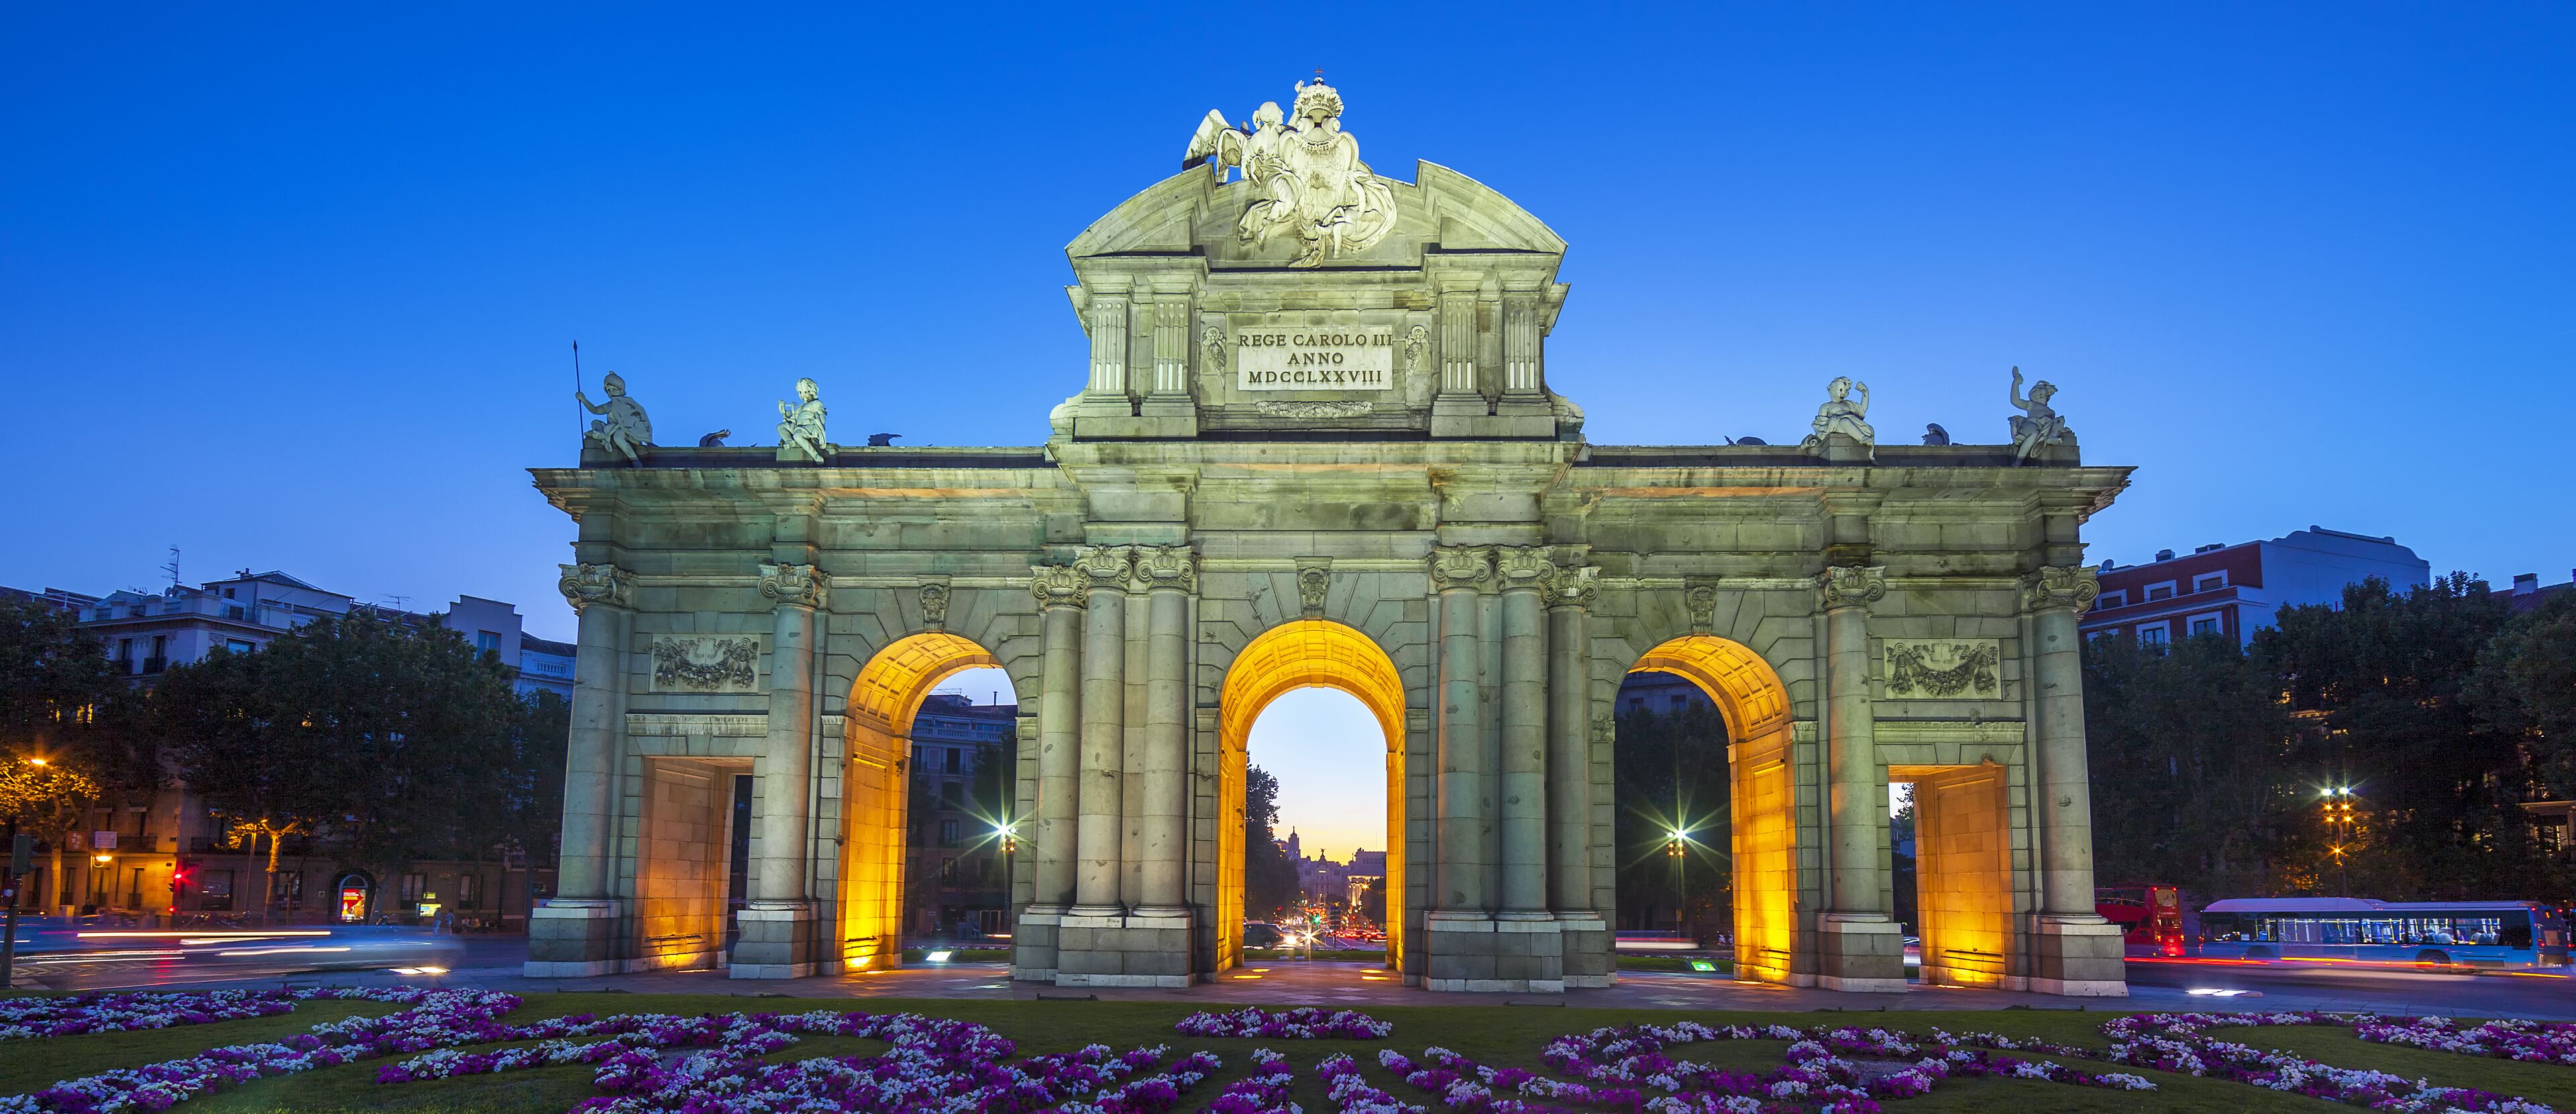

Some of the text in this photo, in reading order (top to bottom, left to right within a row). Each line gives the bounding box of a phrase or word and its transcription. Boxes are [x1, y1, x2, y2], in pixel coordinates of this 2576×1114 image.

[1238, 334, 1393, 346] REGE CAROLO III
[1287, 352, 1344, 365] ANNO
[1248, 370, 1382, 383] MDCCLXXVIII
